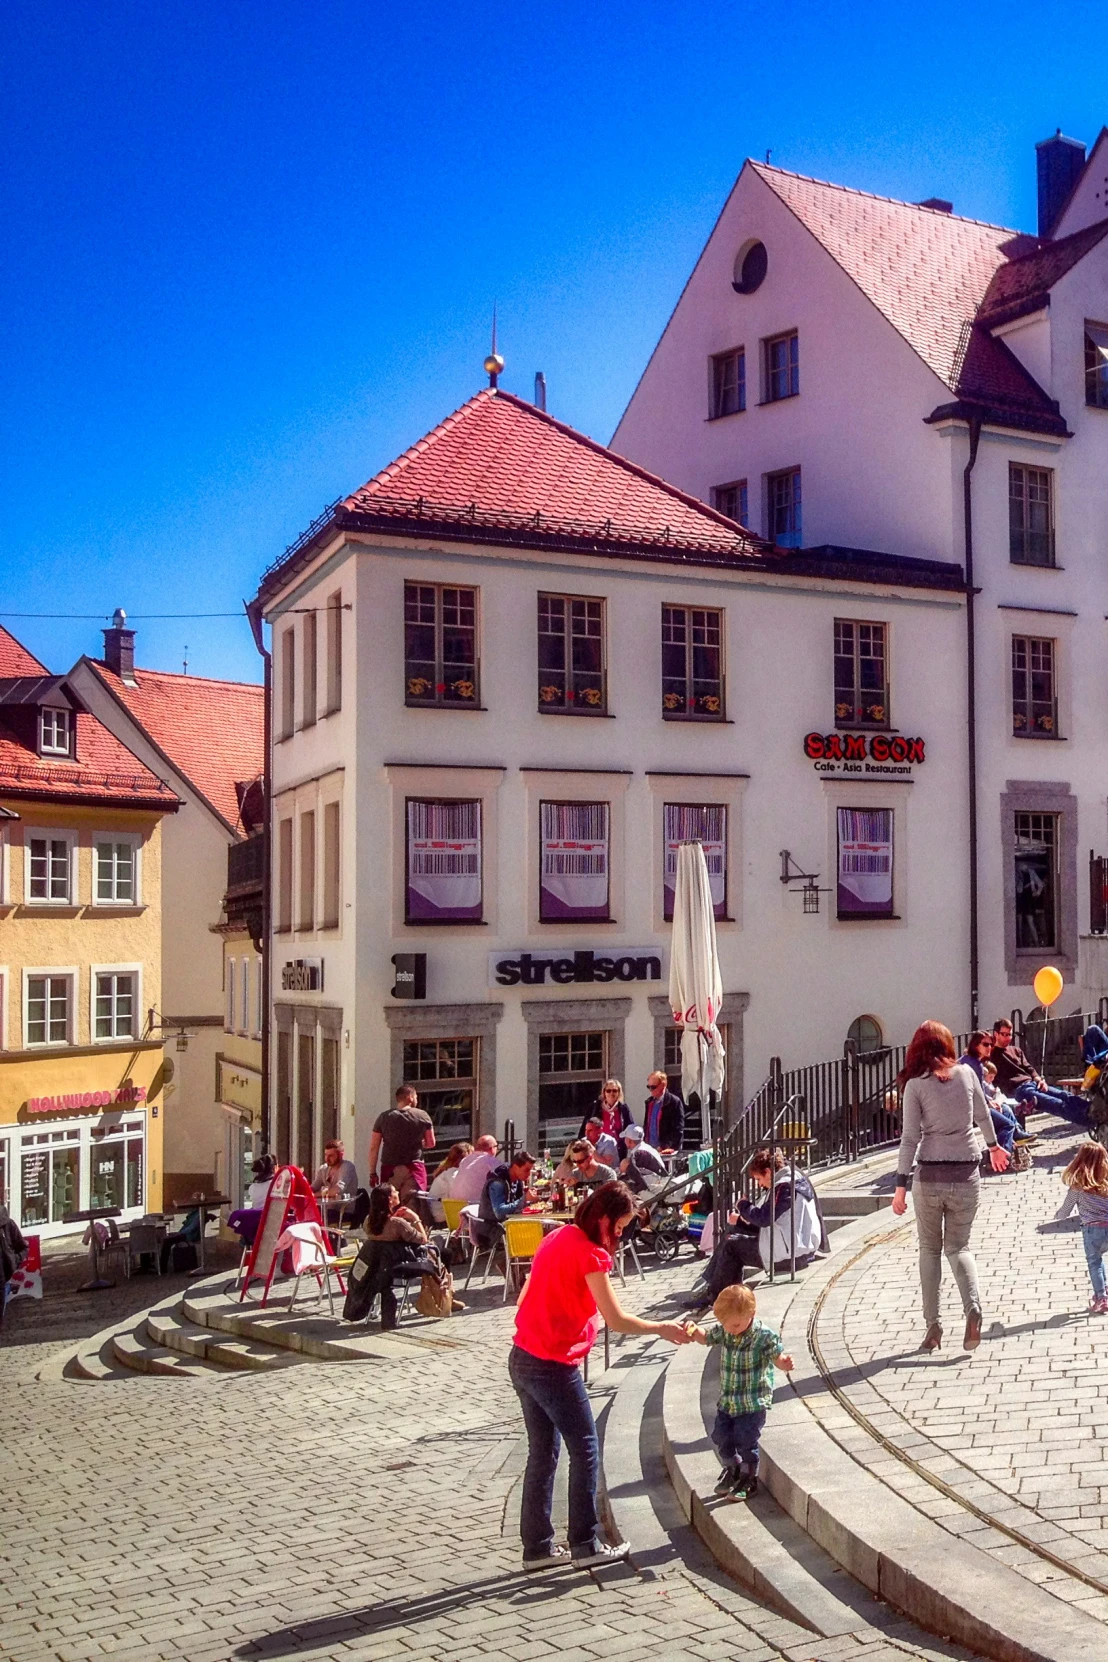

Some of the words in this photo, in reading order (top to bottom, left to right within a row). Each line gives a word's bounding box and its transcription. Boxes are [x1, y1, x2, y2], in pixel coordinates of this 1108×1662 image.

[804, 732, 867, 761] SAM
[870, 735, 925, 763] SON
[814, 762, 836, 771] Cafe
[843, 763, 862, 772] Asia
[865, 764, 911, 774] Restaurant
[495, 951, 661, 985] strellson
[28, 1090, 111, 1113] HOLLYWOOD
